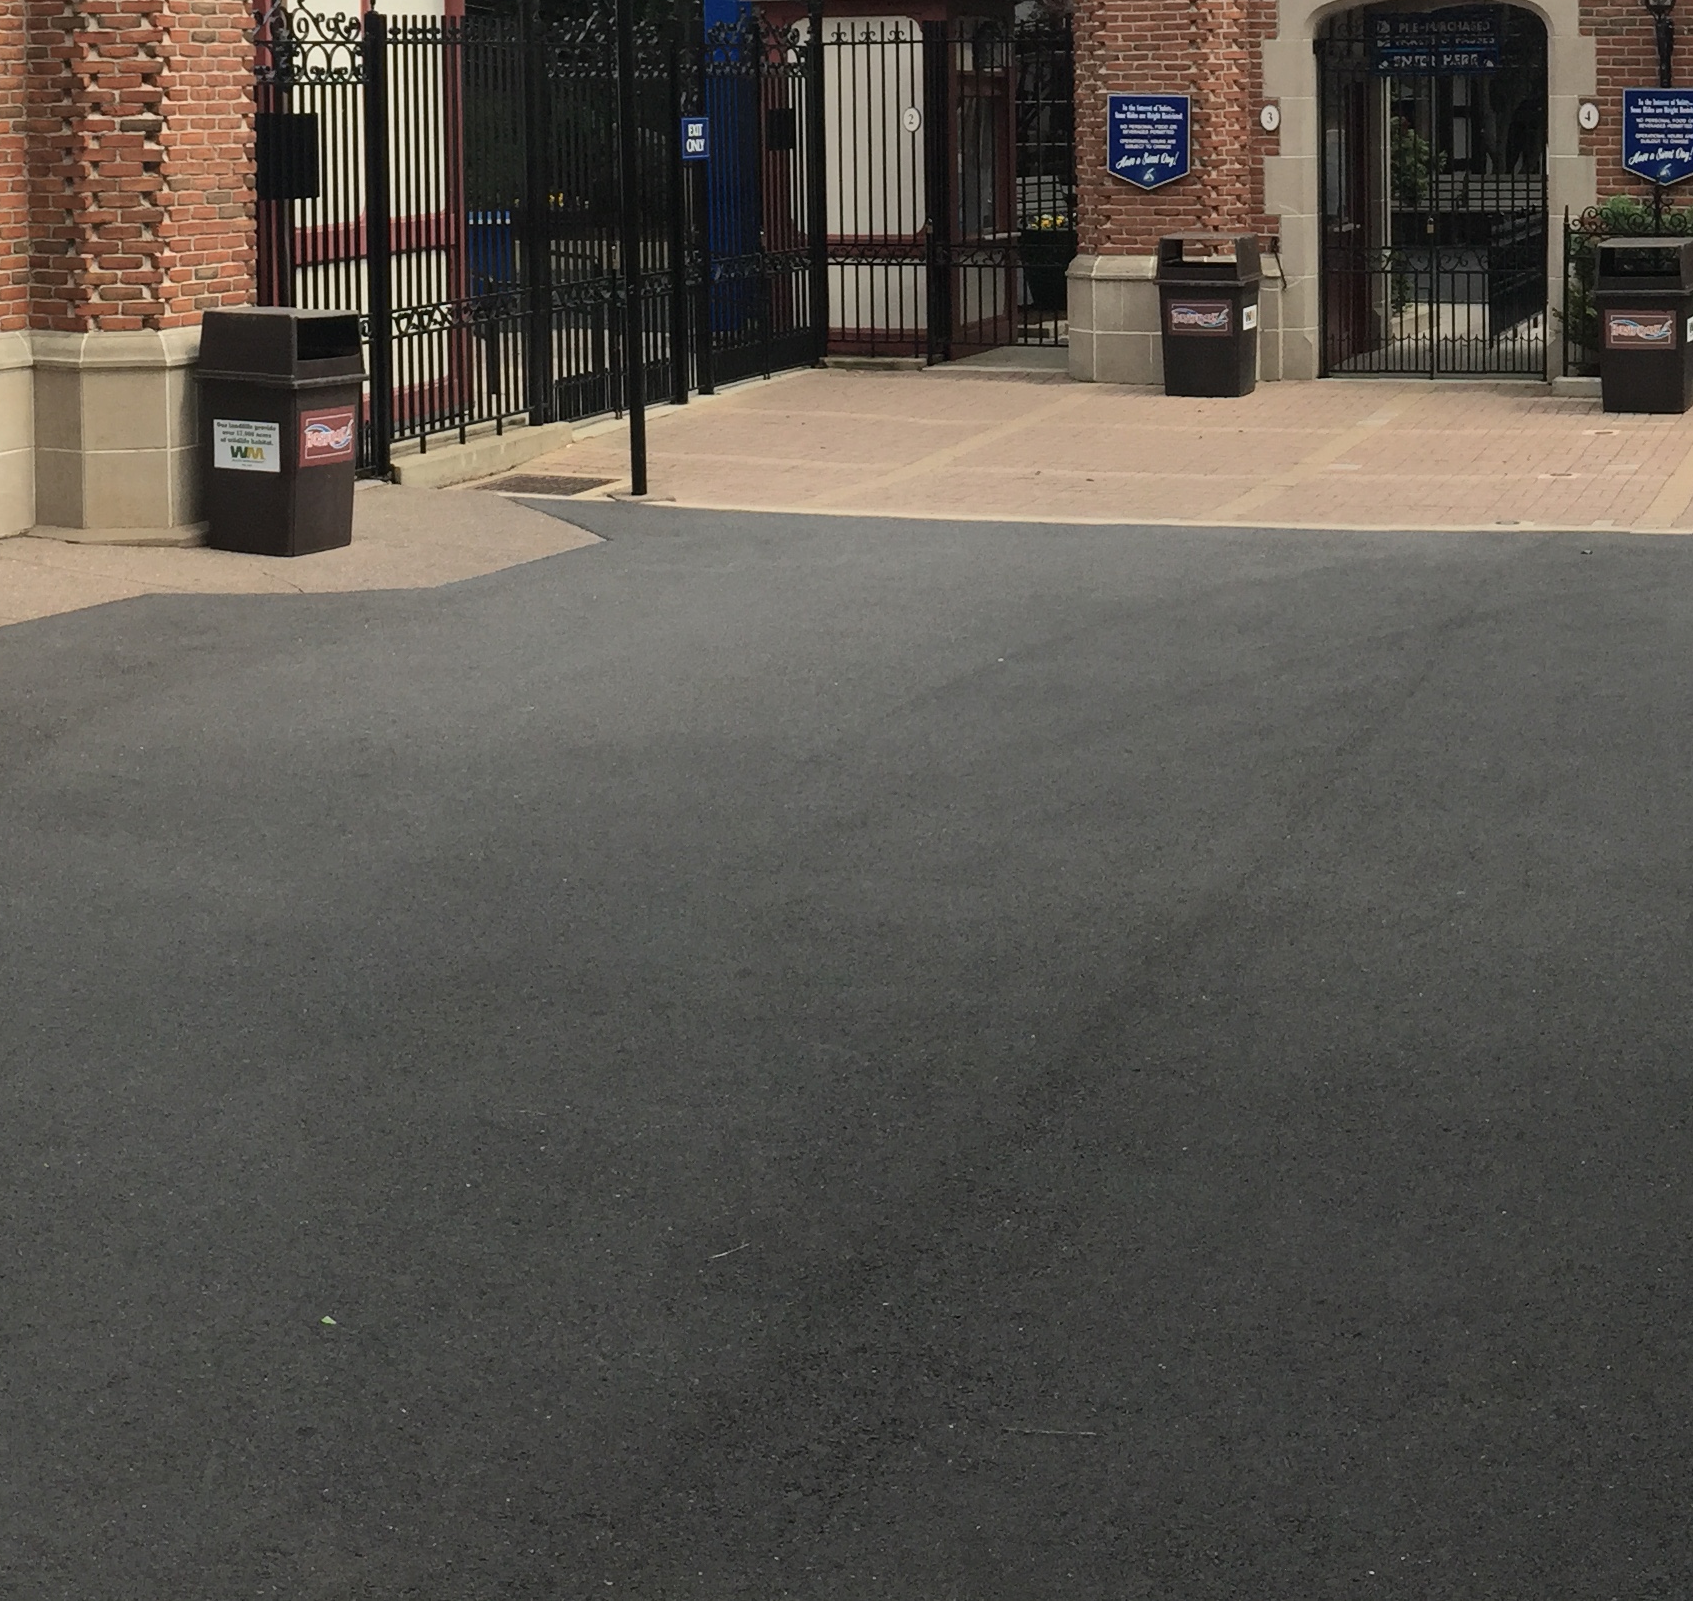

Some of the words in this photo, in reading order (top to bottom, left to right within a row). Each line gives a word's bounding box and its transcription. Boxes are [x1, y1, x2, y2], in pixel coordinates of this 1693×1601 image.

[908, 113, 914, 125] 2
[1266, 112, 1273, 124] 3
[1584, 110, 1591, 122] 4
[688, 123, 703, 137] EXIT
[686, 138, 705, 152] ONLY
[230, 445, 265, 460] WM
